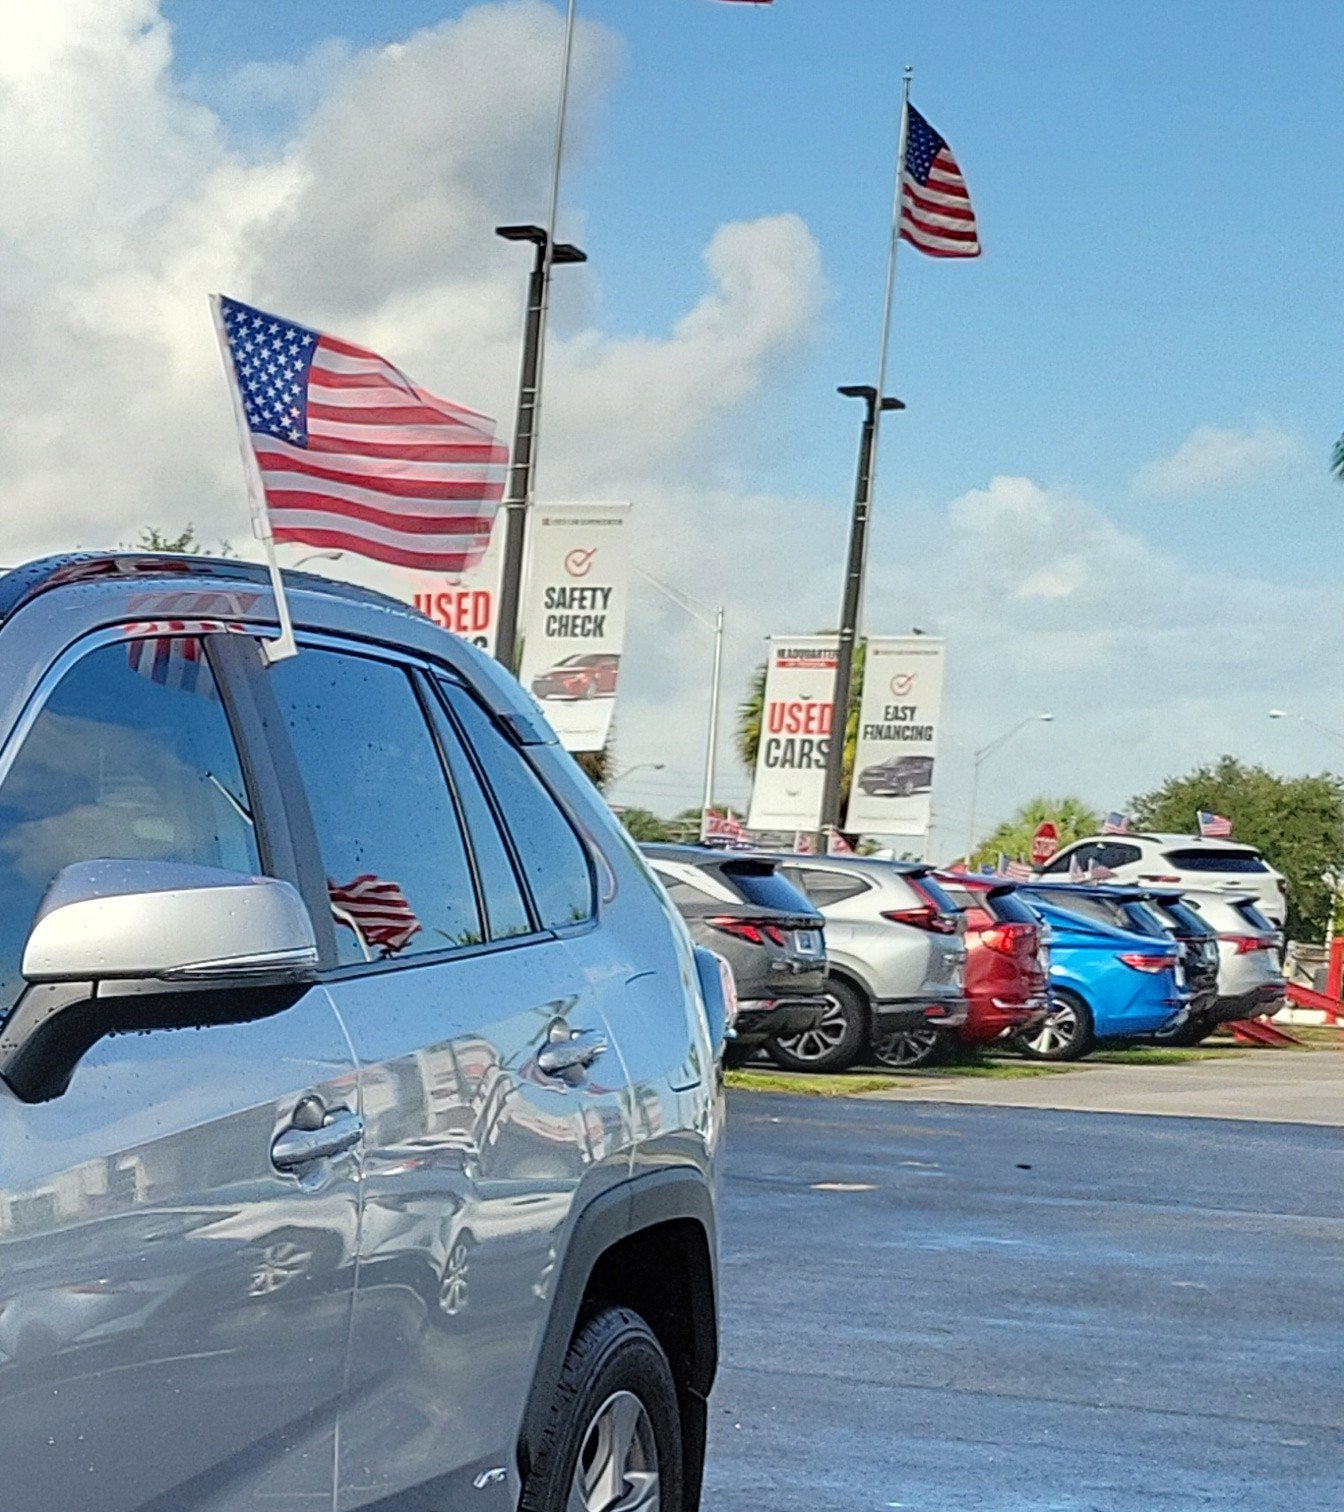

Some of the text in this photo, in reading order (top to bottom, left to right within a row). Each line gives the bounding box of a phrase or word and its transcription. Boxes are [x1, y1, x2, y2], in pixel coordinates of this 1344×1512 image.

[544, 587, 612, 610] SAFETY
[415, 591, 490, 632] USED
[545, 614, 606, 637] CHECK
[769, 702, 833, 734] USED
[884, 704, 917, 721] EASY
[862, 724, 933, 741] FINANCING
[765, 738, 831, 769] CARS
